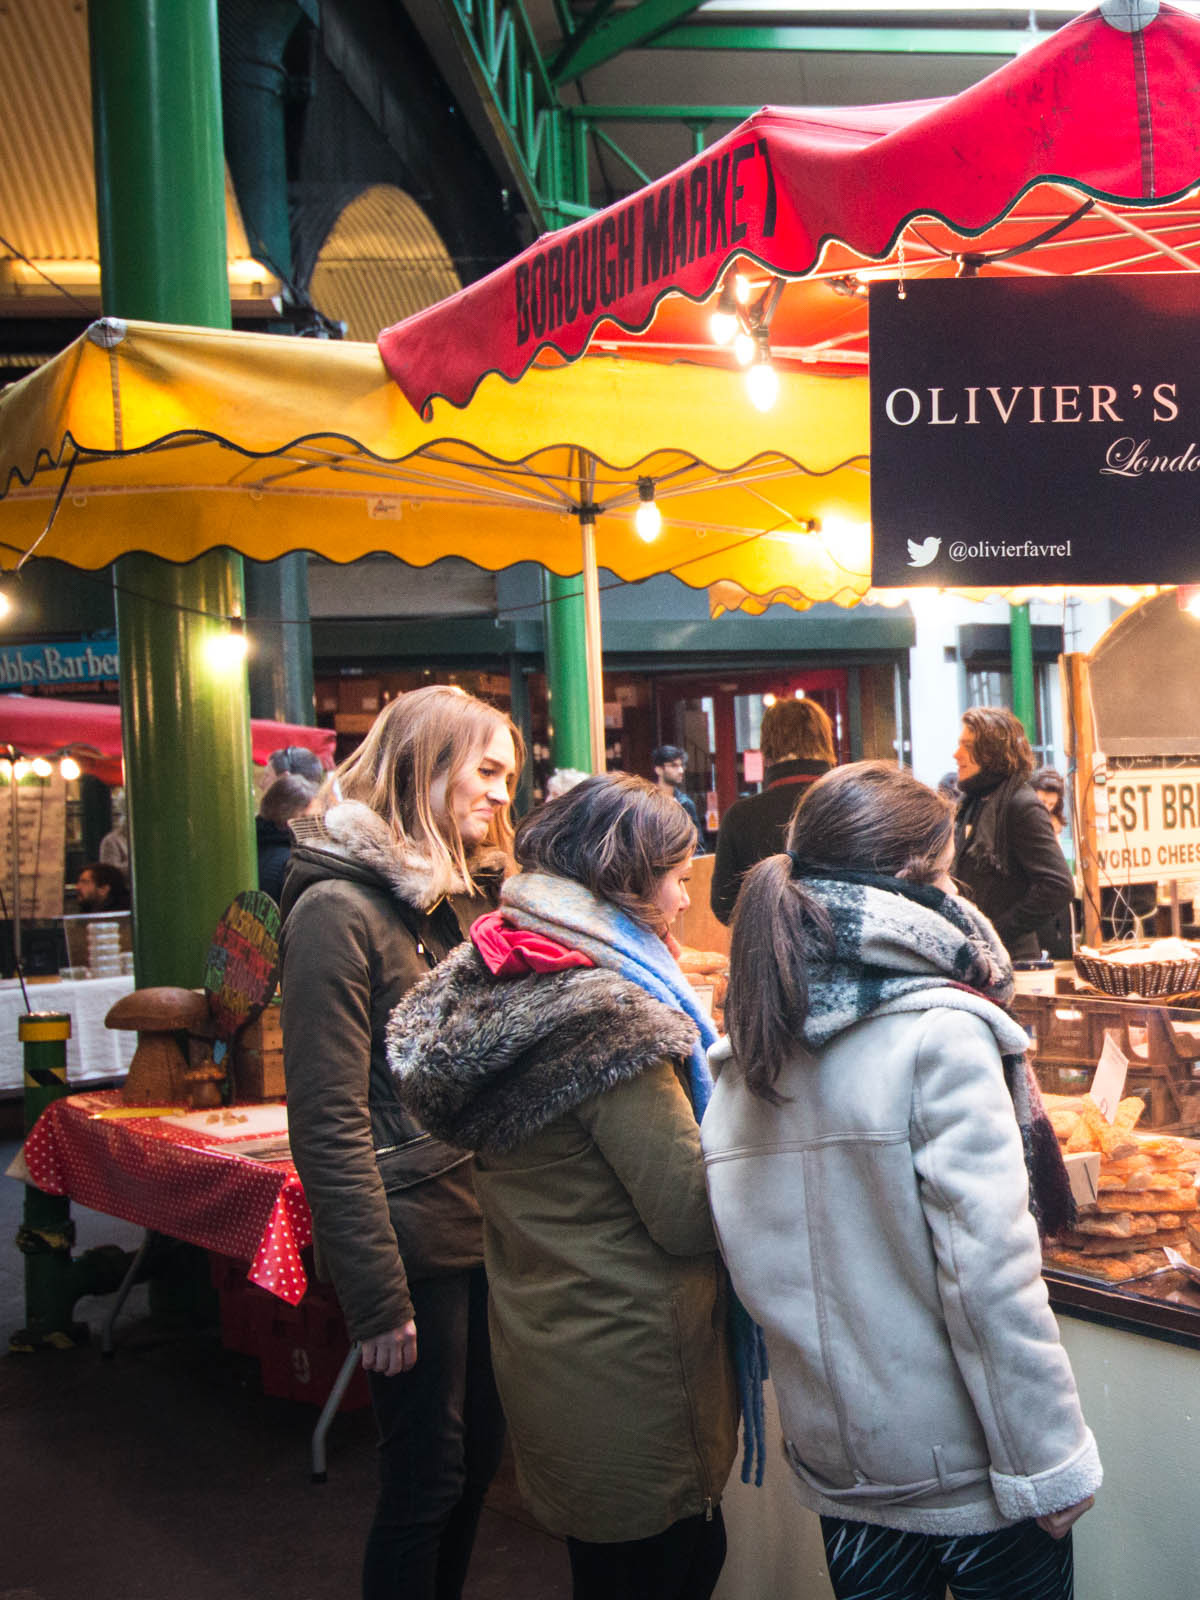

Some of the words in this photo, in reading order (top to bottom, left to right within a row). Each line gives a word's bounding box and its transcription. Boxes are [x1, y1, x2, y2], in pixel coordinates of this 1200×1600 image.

[515, 204, 635, 346] BOROUGH
[641, 138, 777, 287] MARKET
[885, 383, 1180, 426] OLIVIER'S
[948, 540, 1072, 561] @olivierfavrel
